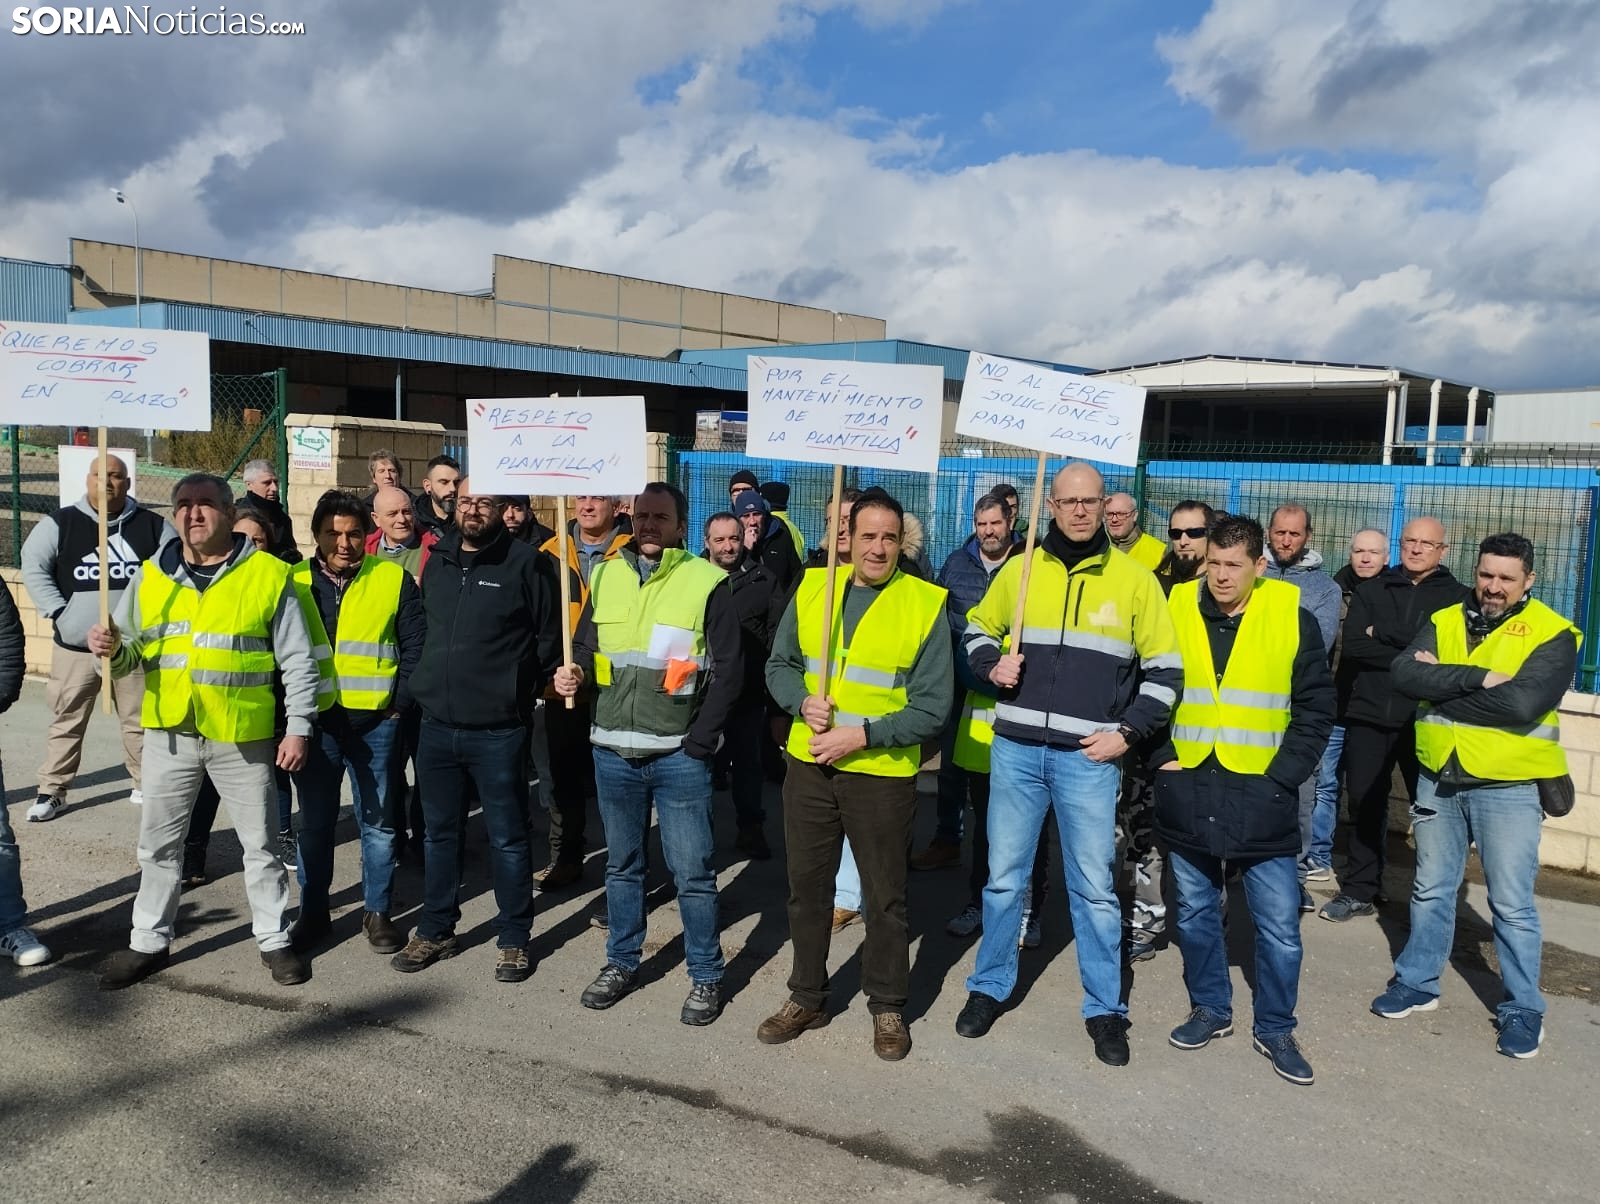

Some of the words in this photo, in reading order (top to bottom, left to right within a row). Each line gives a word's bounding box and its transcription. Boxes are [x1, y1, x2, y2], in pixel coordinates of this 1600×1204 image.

[37, 360, 138, 379] COBRAR
[821, 372, 858, 387] EL
[21, 382, 58, 399] EN
[1018, 374, 1041, 390] AL
[1060, 382, 1115, 405] ERE
[785, 410, 809, 422] DE
[841, 412, 889, 427] TODA
[969, 410, 1025, 431] PARA
[510, 434, 522, 447] A
[552, 434, 576, 447] LA
[768, 431, 786, 442] LA
[73, 561, 140, 580] adda
